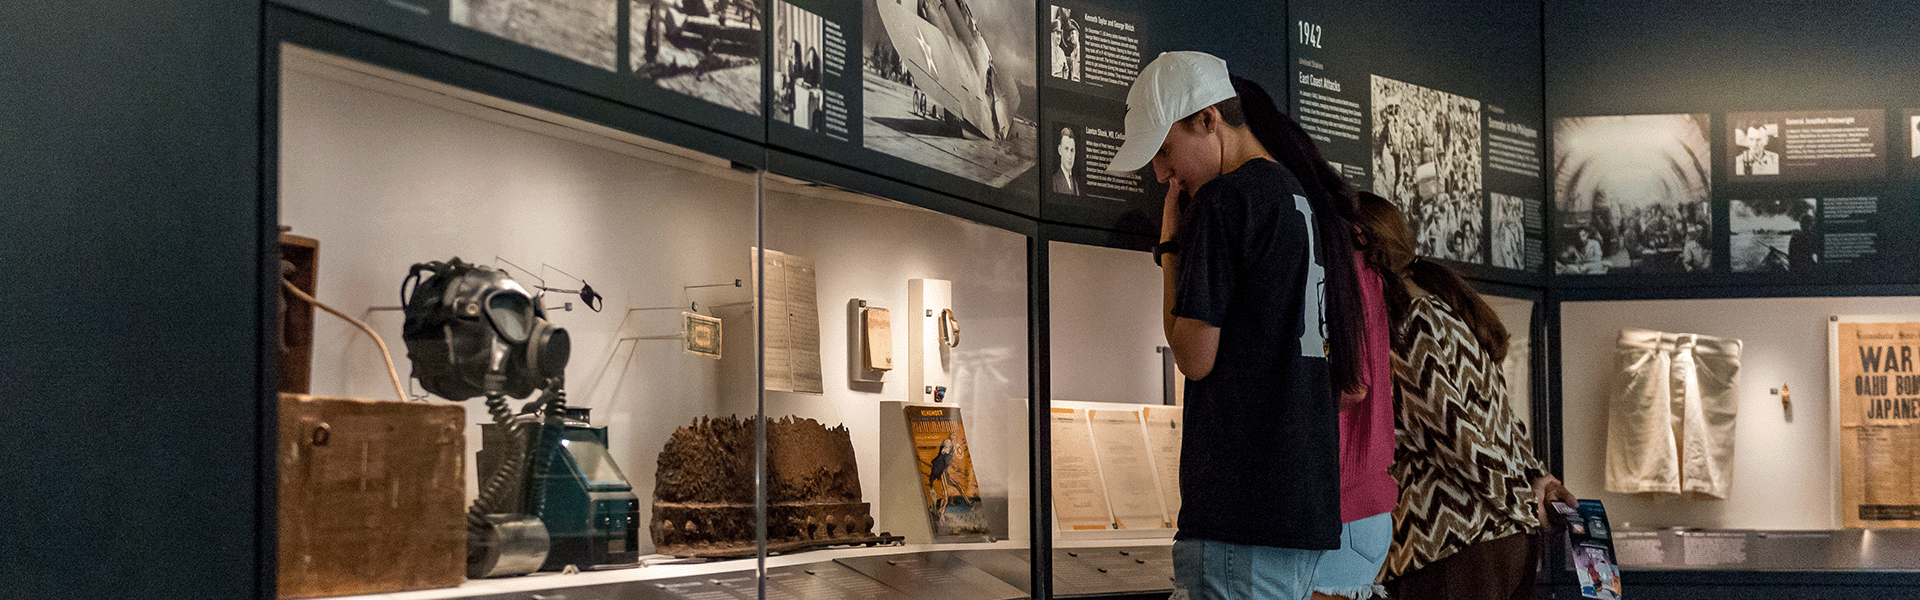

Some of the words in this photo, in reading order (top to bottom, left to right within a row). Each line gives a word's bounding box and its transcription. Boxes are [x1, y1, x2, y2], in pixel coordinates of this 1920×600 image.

[1299, 20, 1322, 48] 1942
[1300, 70, 1310, 85] East
[1310, 74, 1322, 88] Coast
[1324, 77, 1340, 92] Attacks
[1859, 346, 1912, 372] WAR
[1856, 375, 1888, 396] OAHU
[1867, 398, 1920, 419] JAPANE
